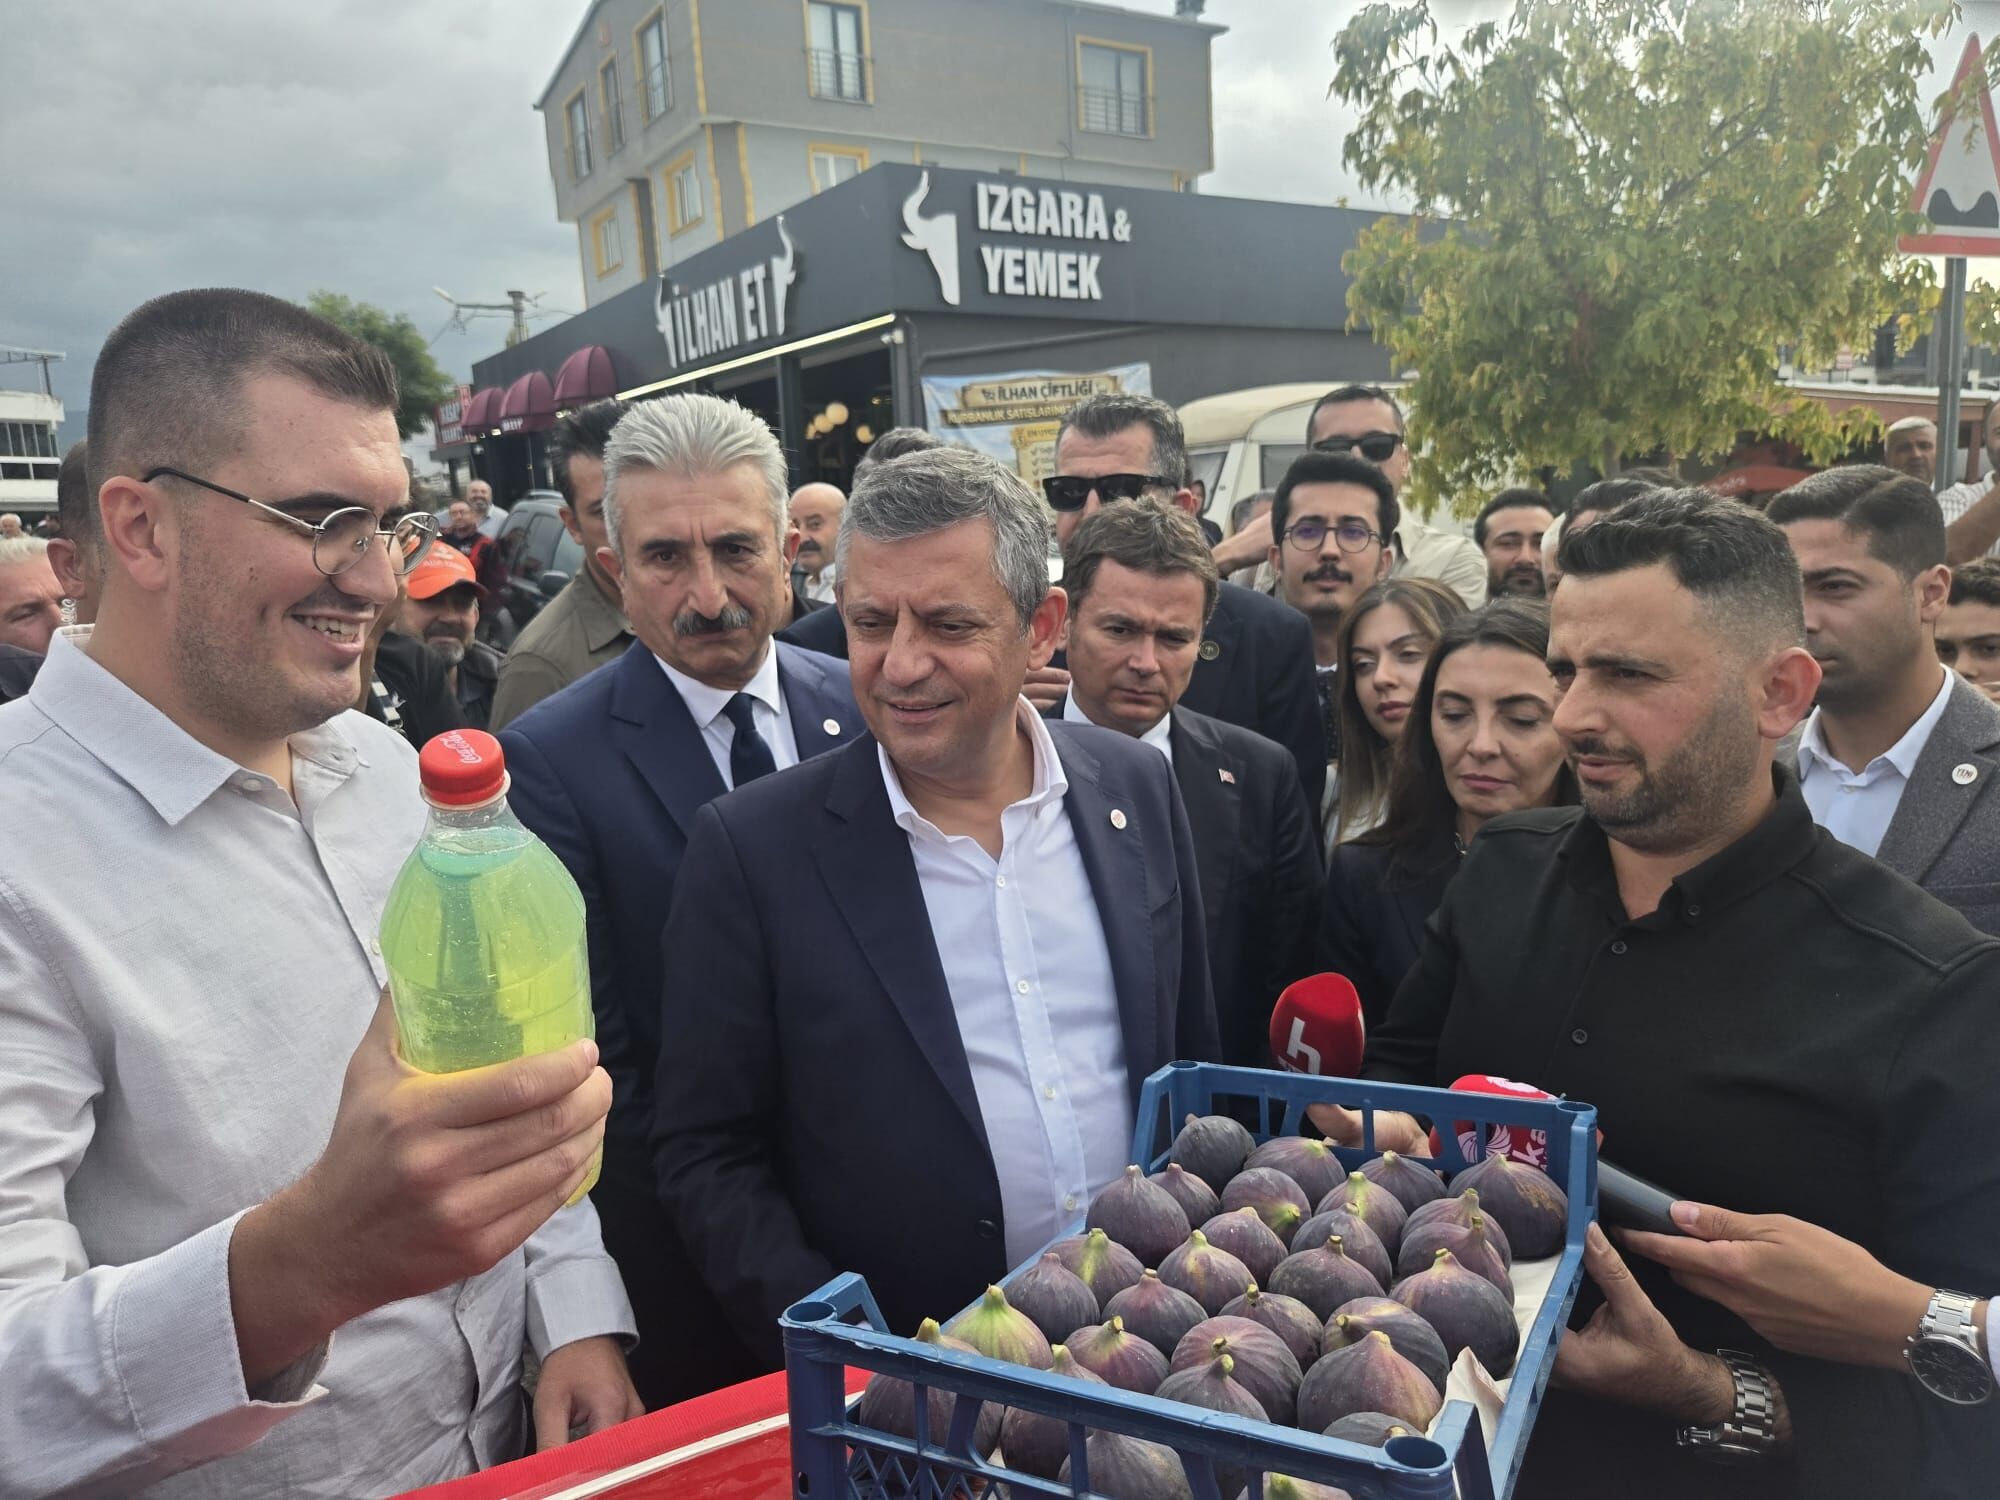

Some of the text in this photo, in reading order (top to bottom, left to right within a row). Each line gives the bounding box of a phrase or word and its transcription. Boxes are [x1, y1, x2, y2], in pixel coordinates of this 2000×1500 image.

[976, 182, 1132, 243] IZGARA &
[980, 245, 1103, 300] YEMEK
[673, 263, 773, 363] İLHAN ET
[999, 379, 1093, 402] İLHAN ÇİFTLİĞİ
